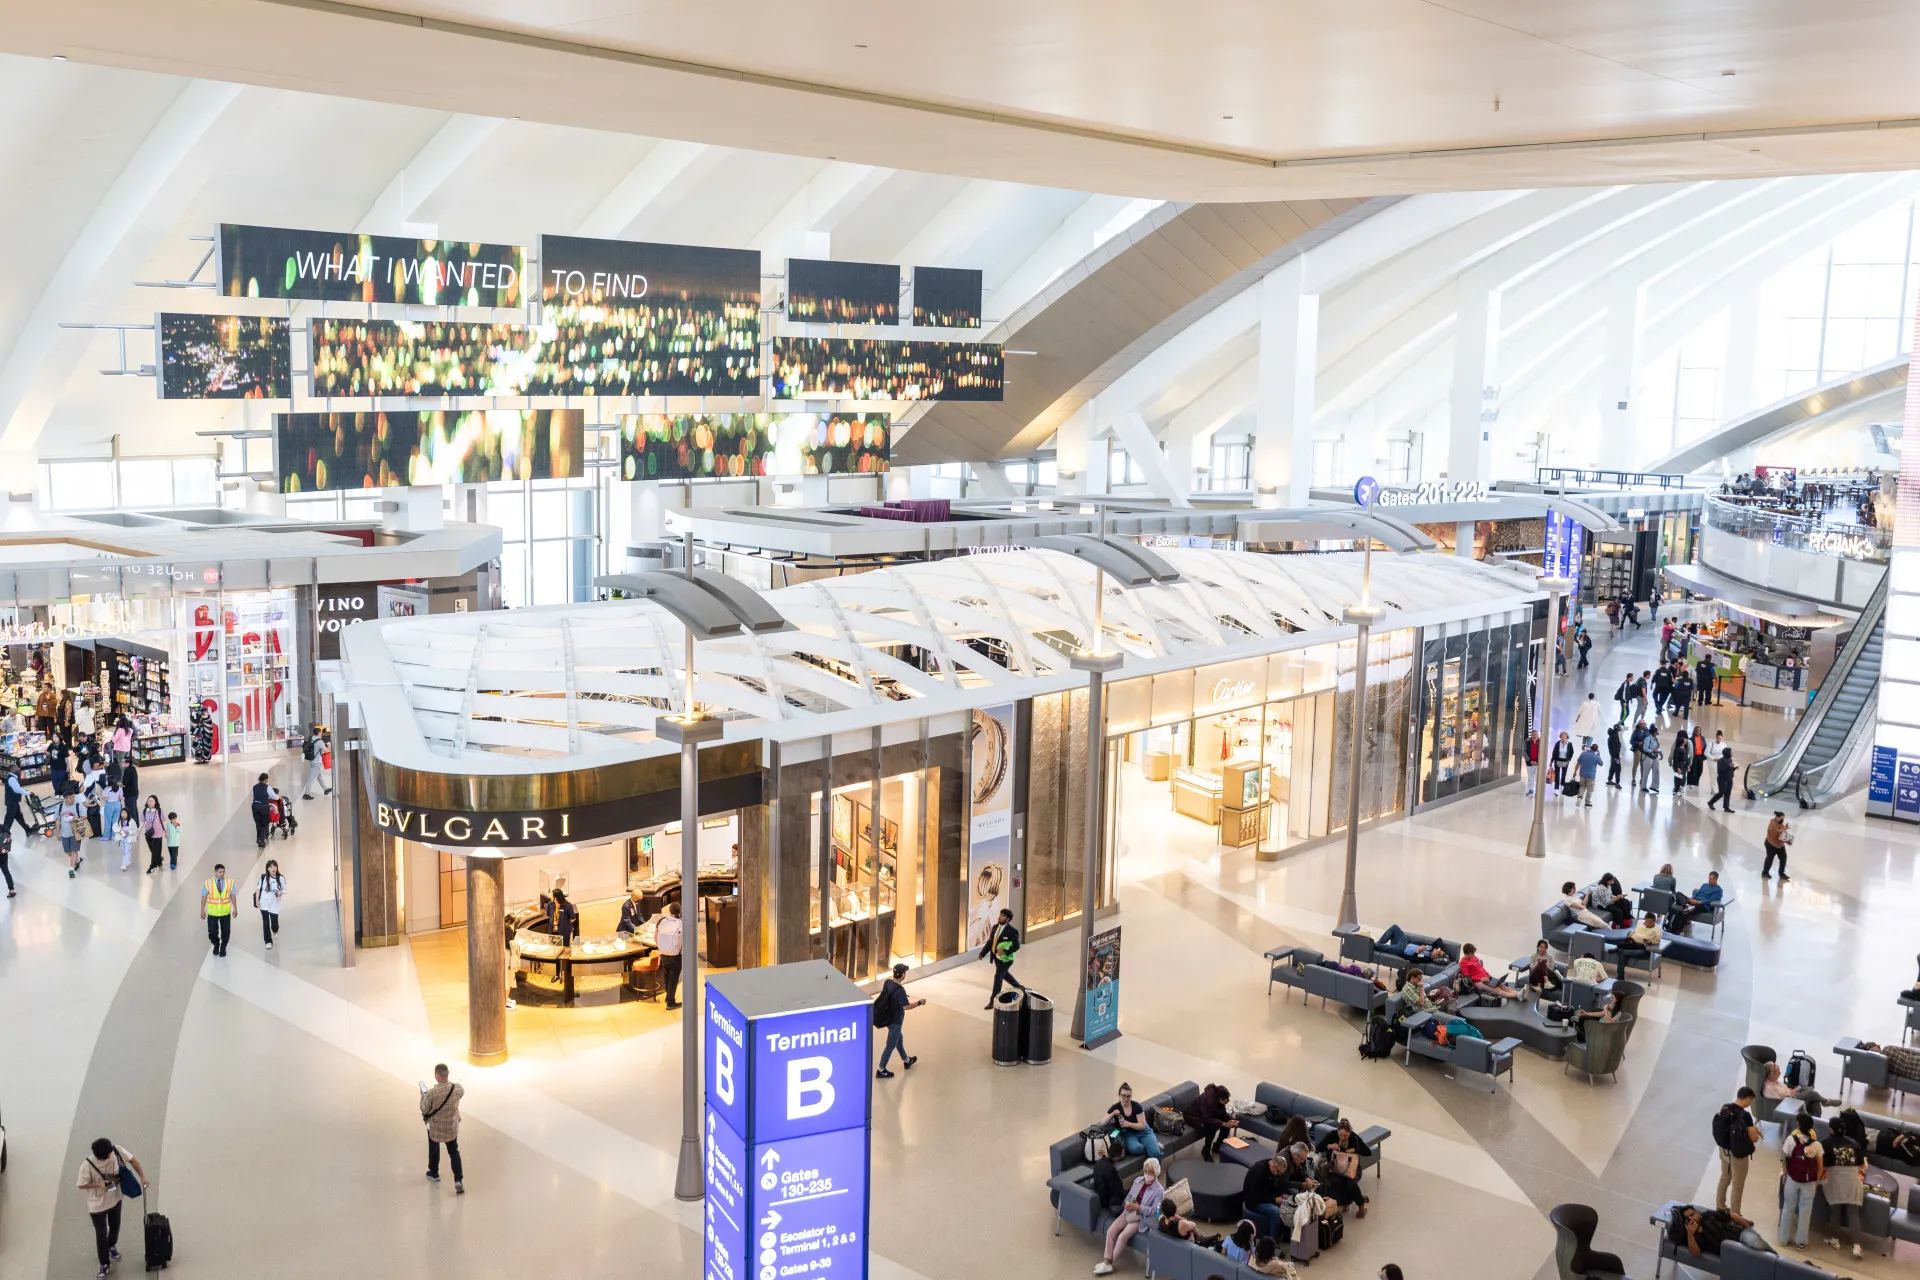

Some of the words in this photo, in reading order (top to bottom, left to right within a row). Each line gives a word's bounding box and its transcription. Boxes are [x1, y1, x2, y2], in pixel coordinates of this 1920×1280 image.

[295, 251, 380, 281] WHAT
[387, 258, 393, 283] I
[402, 258, 516, 290] WANTED
[551, 269, 586, 294] TO
[592, 272, 648, 298] FIND
[1379, 491, 1417, 507] Gates
[1417, 481, 1488, 505] 201-225
[1156, 535, 1178, 547] iStore
[1212, 678, 1256, 702] Cartier
[377, 803, 570, 841] BVLGARI
[709, 1001, 742, 1048] Terminal
[766, 1021, 857, 1052] Terminal
[716, 1036, 735, 1106] B
[787, 1055, 836, 1121] B
[781, 1168, 819, 1185] Gates
[781, 1177, 832, 1198] 130-235
[780, 1227, 825, 1243] Escalator
[825, 1224, 837, 1234] to
[780, 1238, 820, 1256] Terminal
[821, 1238, 831, 1249] 1,
[832, 1235, 839, 1246] 2
[840, 1233, 848, 1244] &
[849, 1232, 856, 1243] 3
[780, 1262, 809, 1277] Gates
[809, 1256, 832, 1271] 9-38
